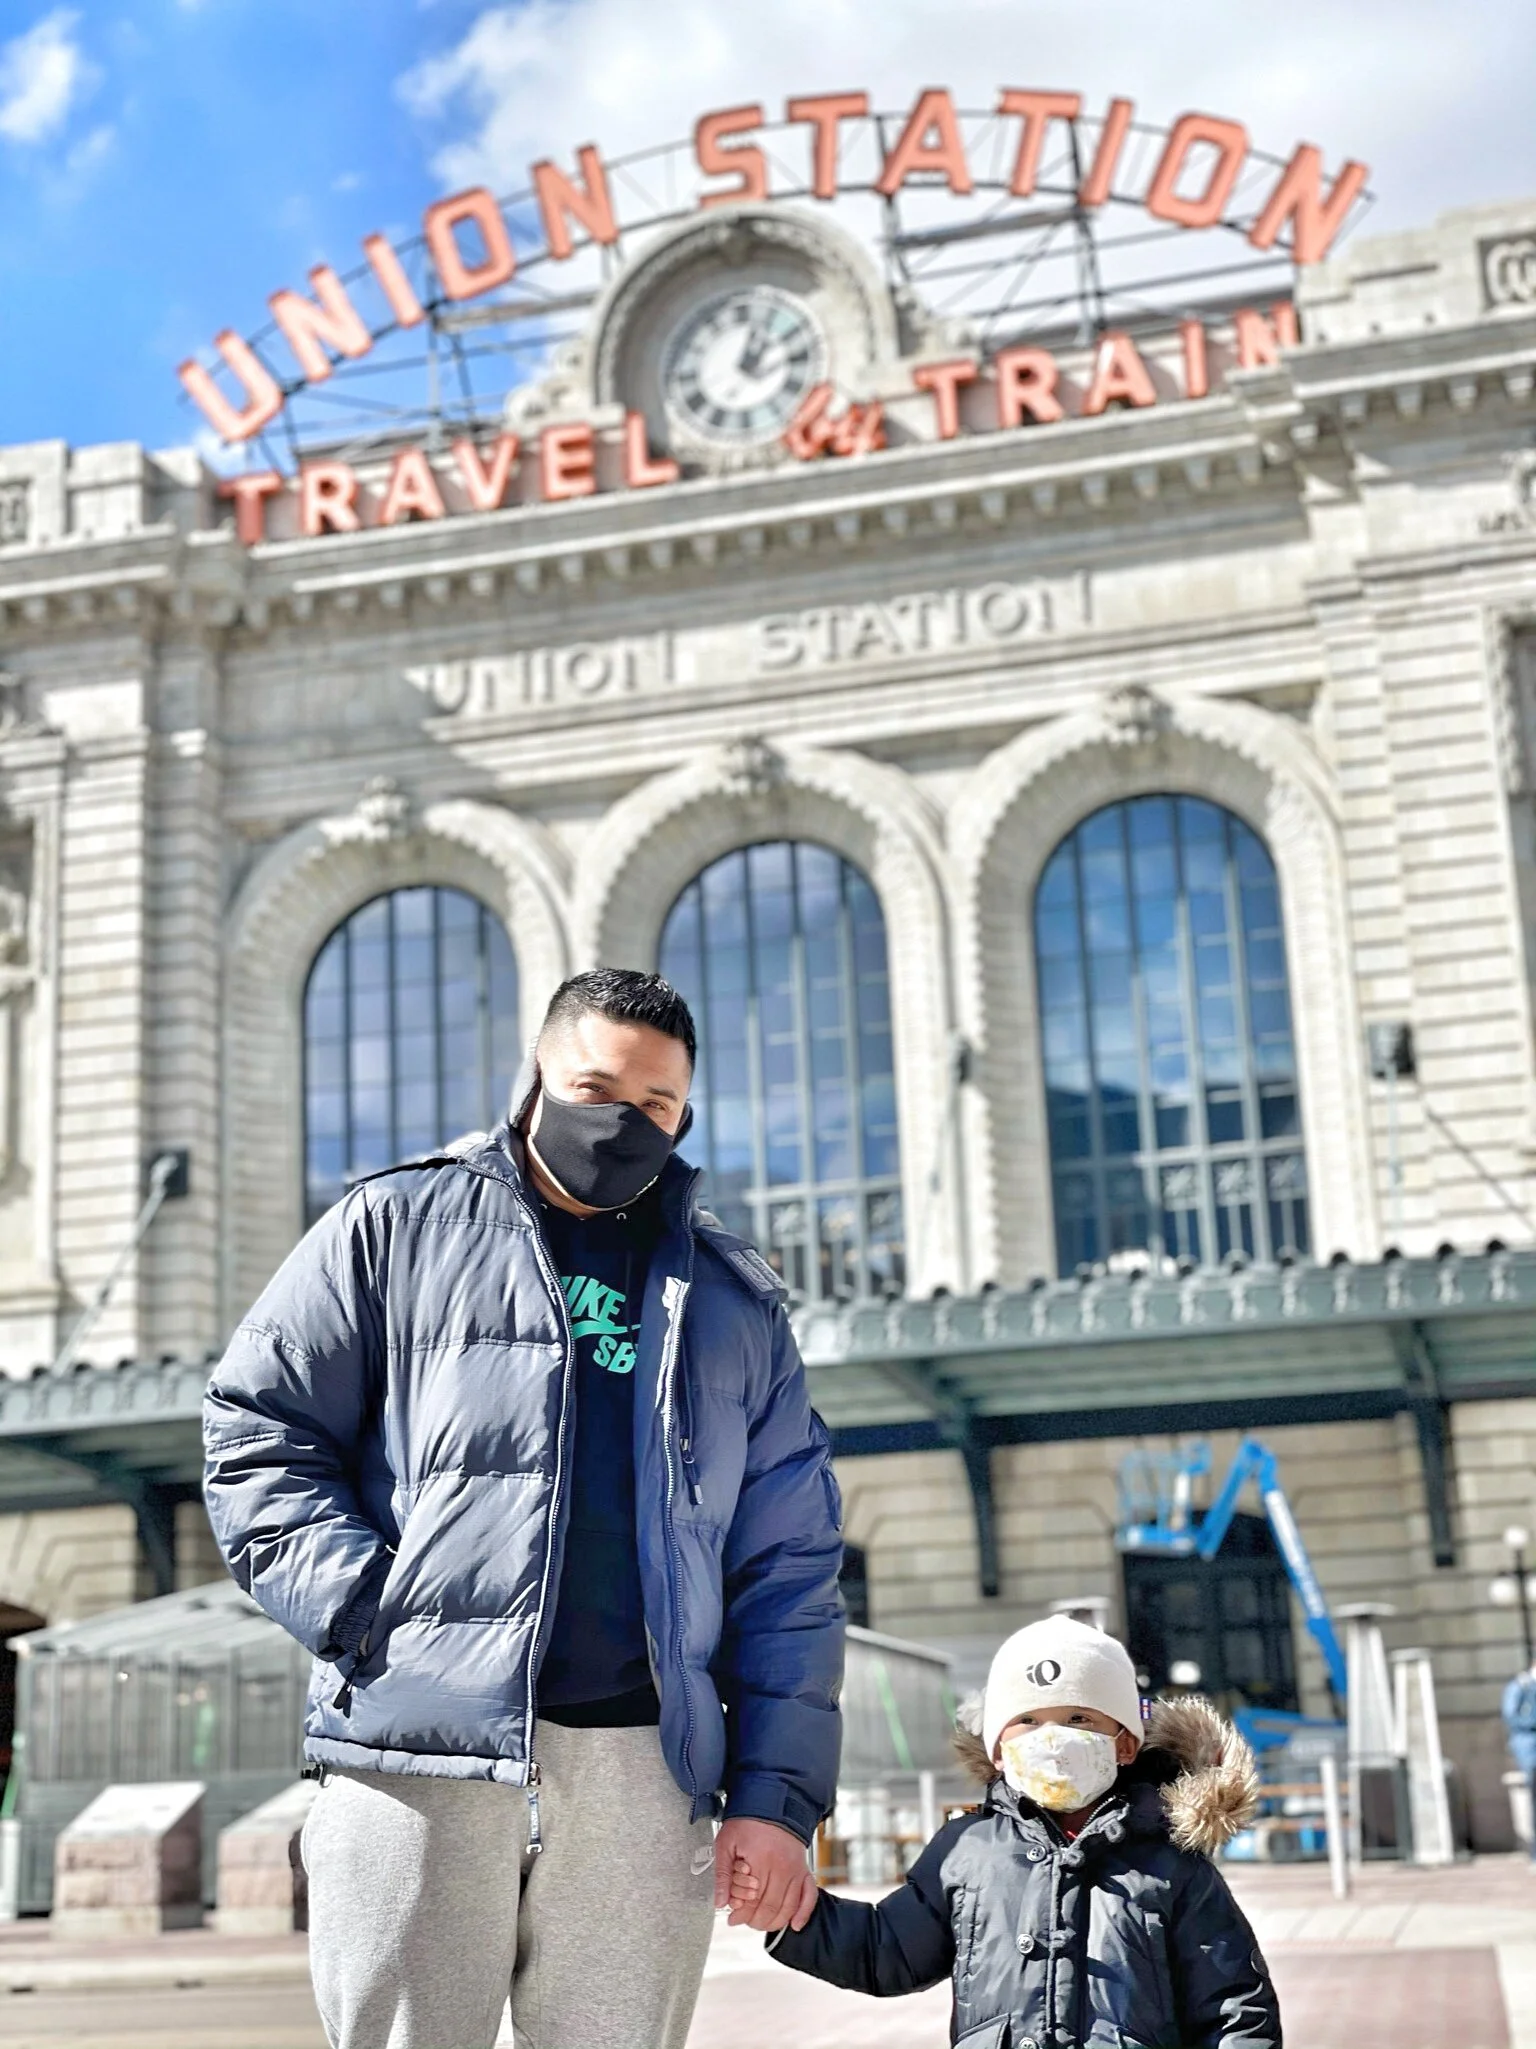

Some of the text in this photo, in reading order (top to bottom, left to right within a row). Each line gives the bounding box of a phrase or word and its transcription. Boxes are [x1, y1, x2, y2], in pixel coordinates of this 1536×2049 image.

[178, 88, 1369, 442] UNION STATION
[219, 410, 680, 545] TRAVEL
[914, 300, 1299, 440] TRAIN
[427, 568, 1093, 717] UNION STATION
[560, 1275, 626, 1326] IKE
[592, 1335, 637, 1373] SB
